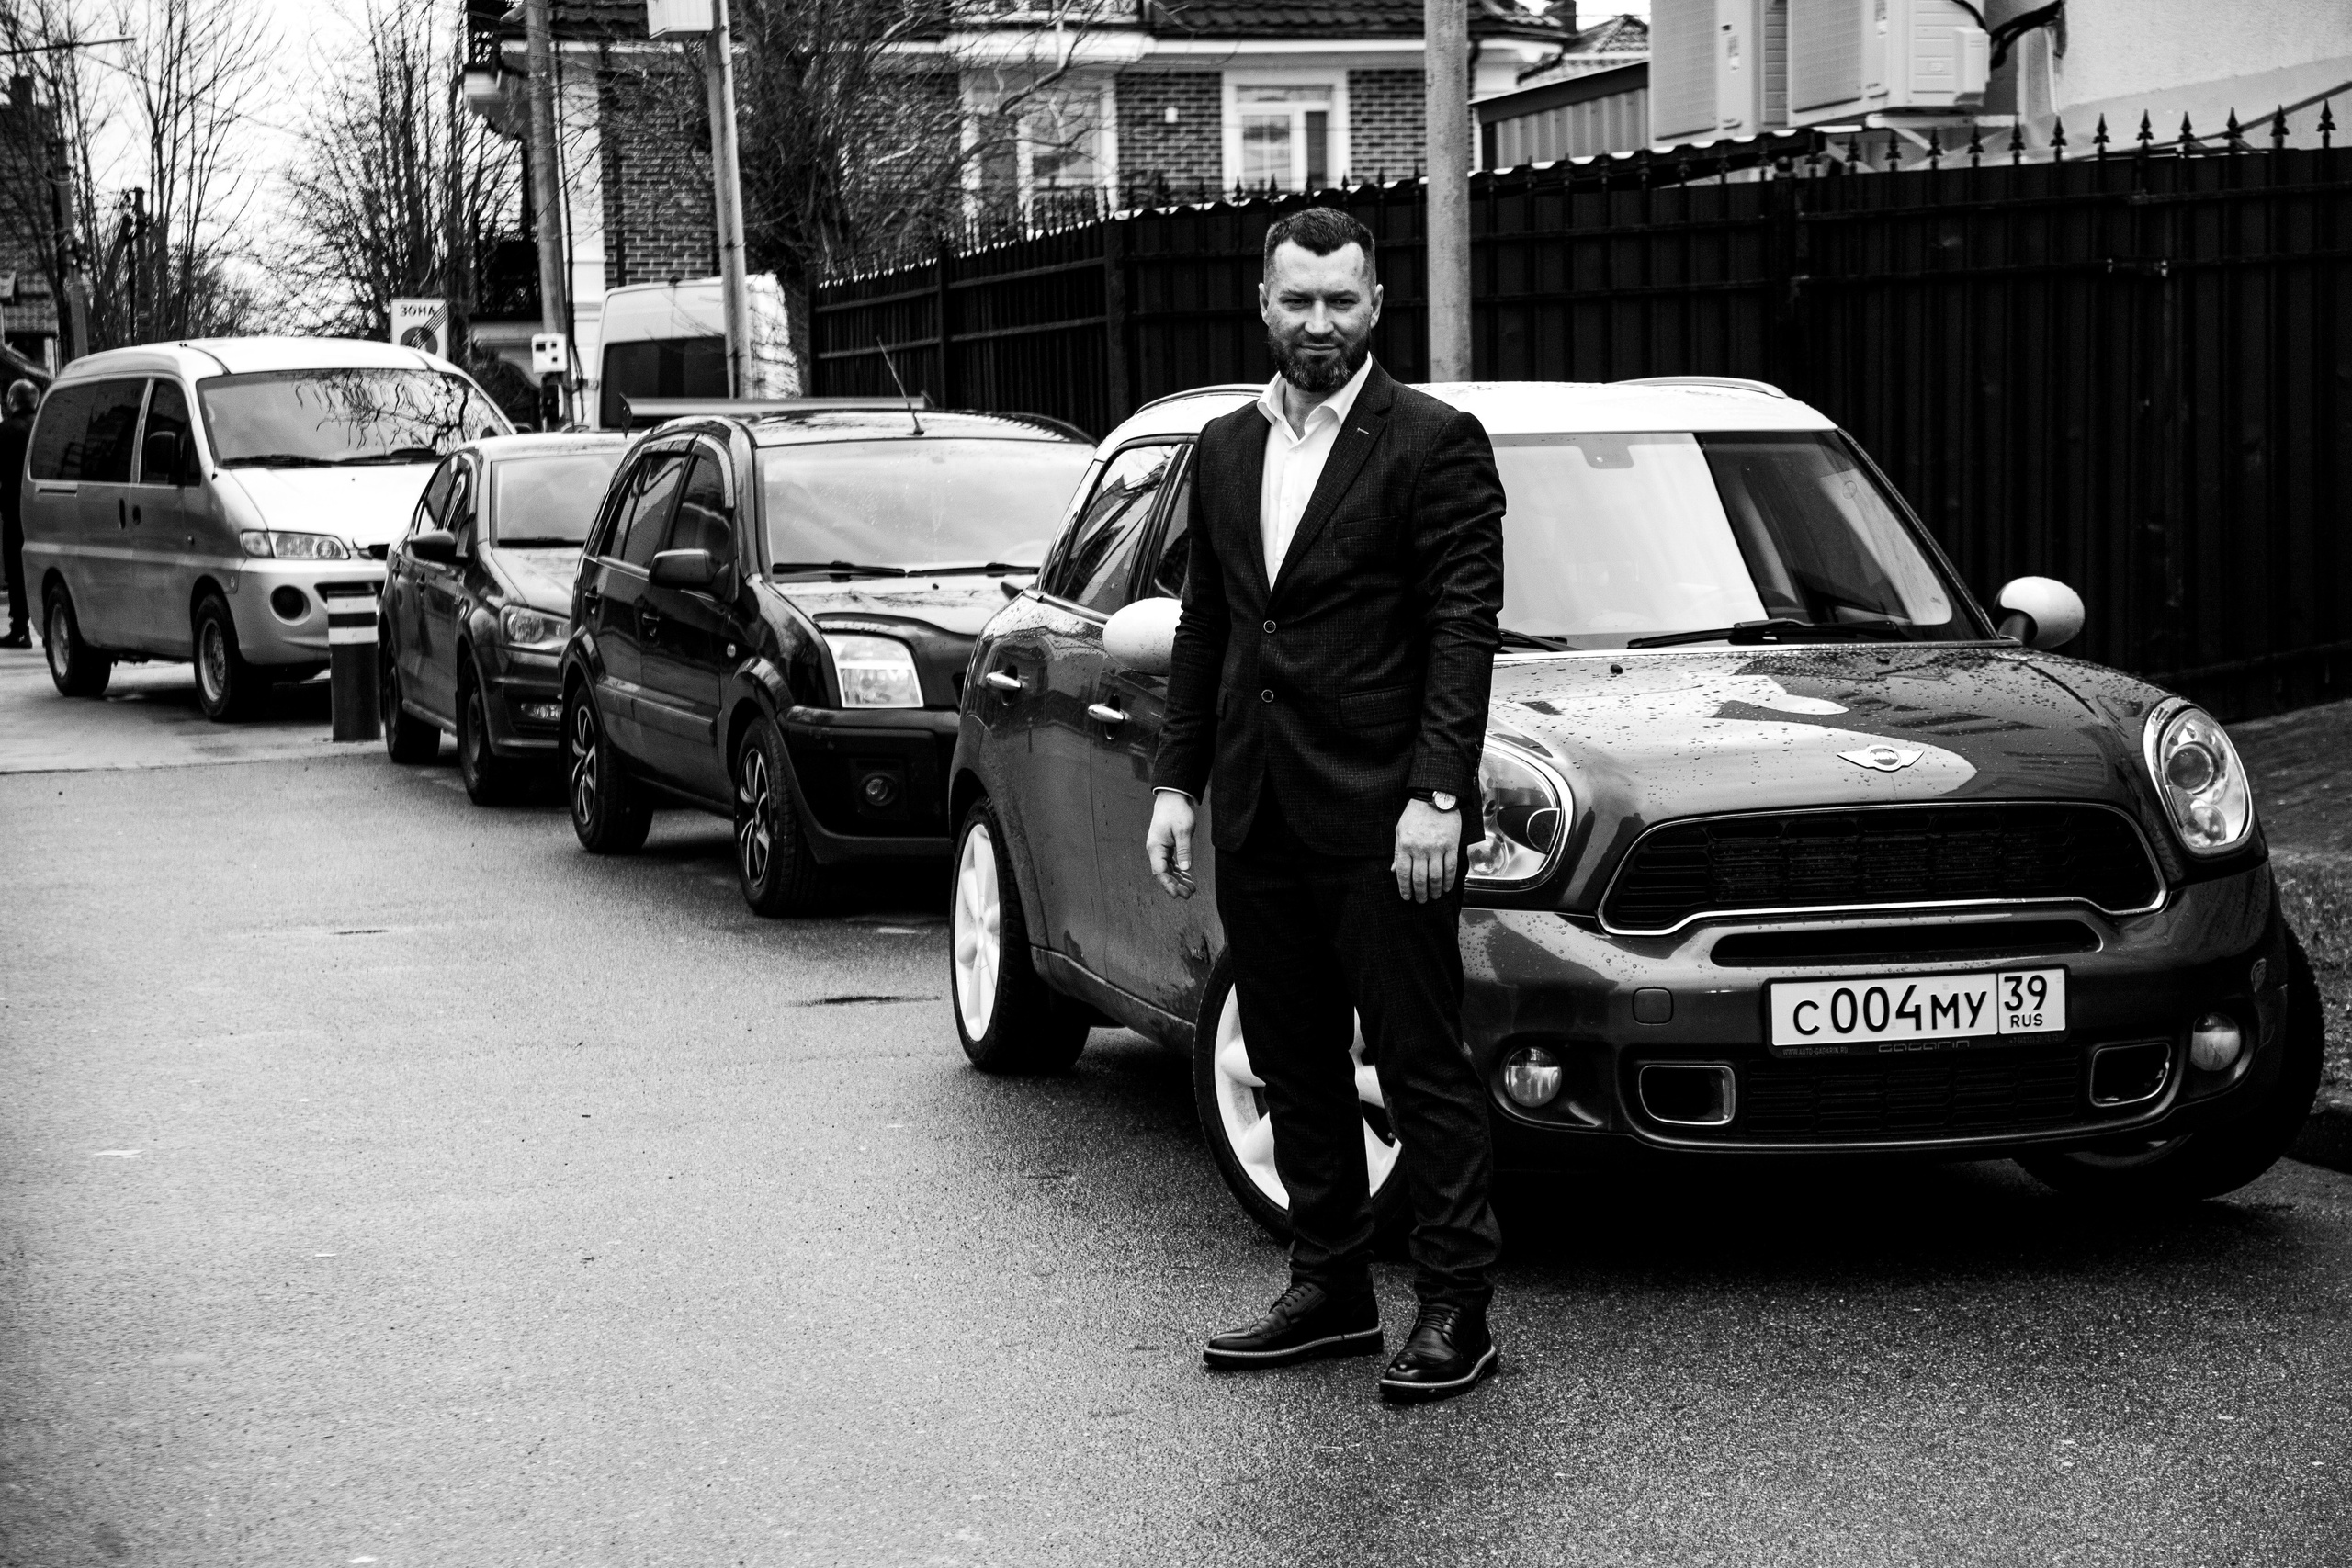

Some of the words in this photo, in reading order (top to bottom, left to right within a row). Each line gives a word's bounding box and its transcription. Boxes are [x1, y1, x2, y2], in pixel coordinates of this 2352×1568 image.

[400, 304, 436, 317] ЗОНА
[2004, 974, 2048, 1011] 39
[2010, 1014, 2043, 1028] RUS
